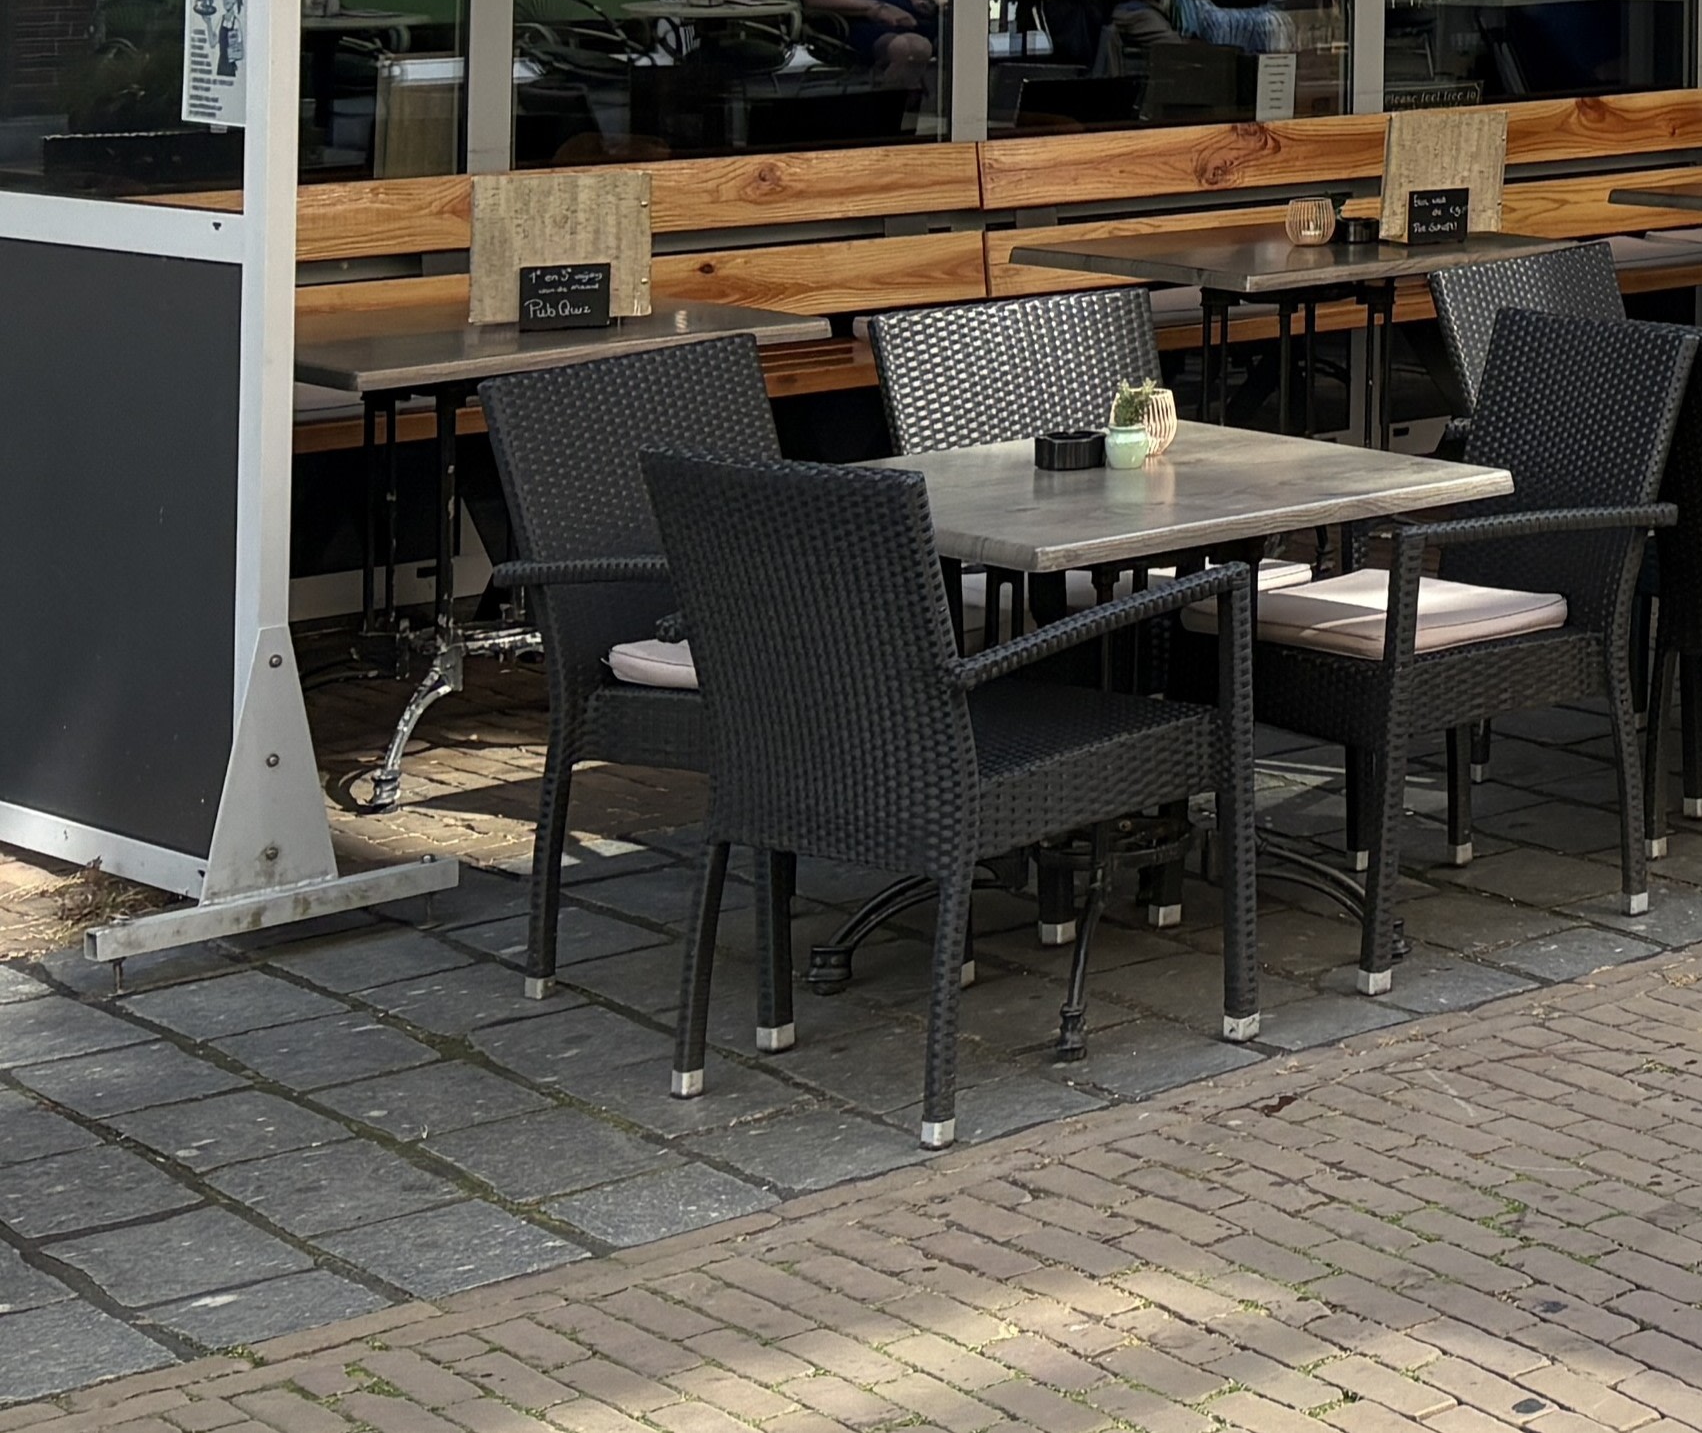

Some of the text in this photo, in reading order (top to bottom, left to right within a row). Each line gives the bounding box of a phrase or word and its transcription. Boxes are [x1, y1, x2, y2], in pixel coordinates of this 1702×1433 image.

[544, 274, 558, 282] en
[524, 298, 591, 319] Pub Quiz
